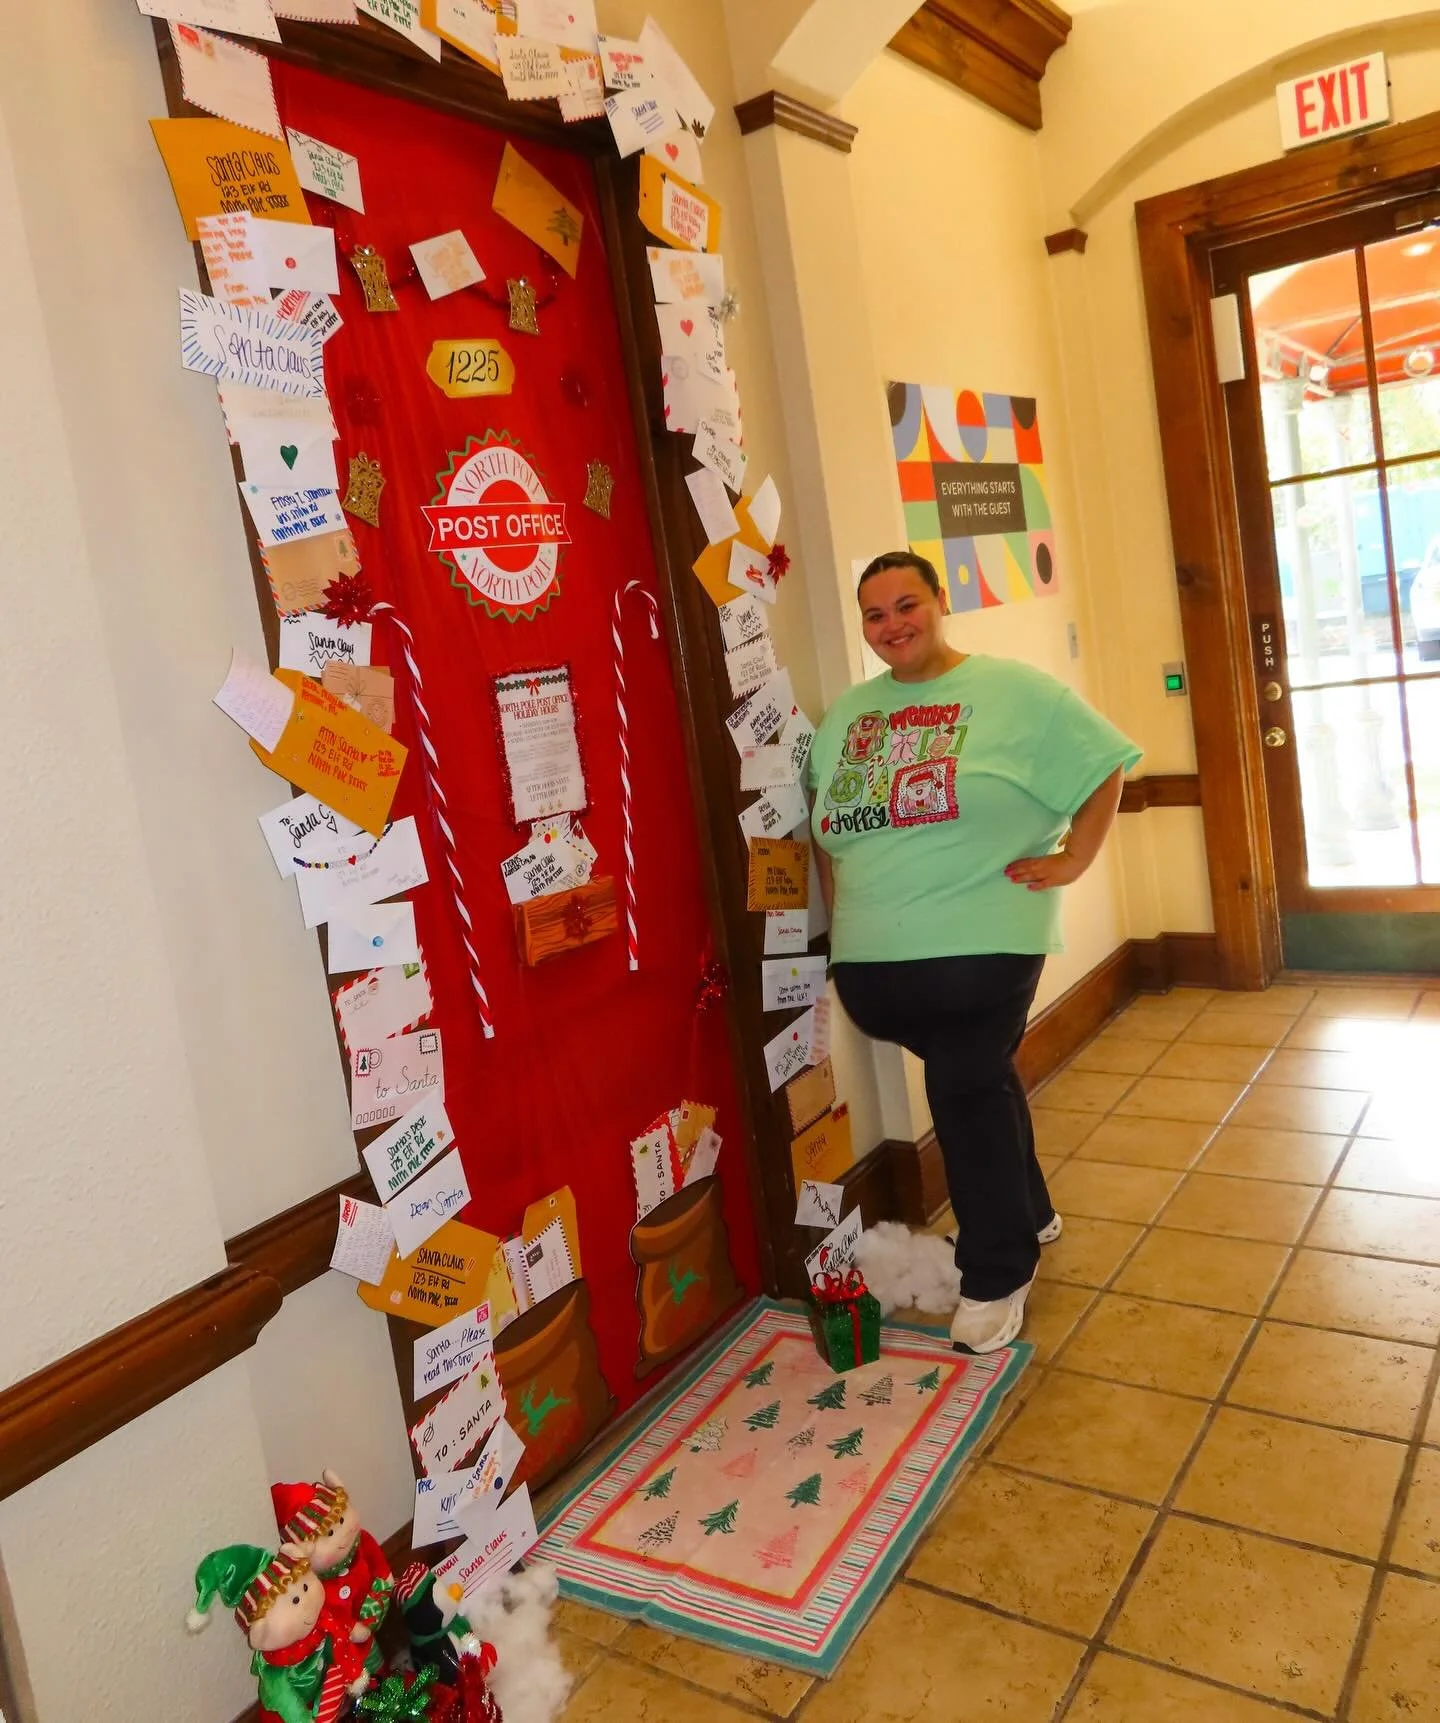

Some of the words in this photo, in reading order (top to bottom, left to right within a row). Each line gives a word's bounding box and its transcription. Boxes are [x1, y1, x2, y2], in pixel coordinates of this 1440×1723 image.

[1295, 61, 1370, 139] EXIT
[206, 152, 245, 187] Santa
[242, 150, 281, 178] Claus
[221, 185, 239, 199] 123
[213, 325, 276, 372] Santa
[277, 346, 312, 379] Claus
[446, 349, 500, 385] 1225
[455, 452, 509, 496] NORTH
[512, 454, 541, 496] POLE
[941, 481, 989, 496] EVERYTHING
[989, 480, 1016, 495] STARTS
[951, 502, 973, 518] WITH
[973, 502, 989, 516] THE
[988, 501, 1011, 515] GUEST
[438, 515, 500, 542] POST
[506, 513, 564, 538] OFFICE
[469, 557, 521, 601] NORTH
[522, 557, 552, 596] POLE
[308, 631, 336, 651] Santa
[1261, 623, 1275, 667] PUSH
[513, 706, 541, 721] HOLIDAY
[540, 704, 560, 717] HOURS
[520, 698, 536, 712] POLE
[536, 696, 551, 709] POST
[551, 693, 570, 706] OFFICE
[289, 812, 322, 849] Santa
[830, 804, 890, 835] Jolly
[376, 1078, 391, 1099] to
[396, 1065, 440, 1095] Santa
[654, 1140, 665, 1179] SANTA
[410, 1199, 433, 1220] Dear
[432, 1189, 464, 1216] Santa
[417, 1247, 443, 1267] SANTA
[441, 1252, 465, 1272] CLAUS
[412, 1271, 426, 1286] 123
[423, 1366, 441, 1385] read
[434, 1444, 449, 1463] TO
[459, 1399, 493, 1441] SANTA
[472, 1452, 490, 1481] Emma
[433, 1554, 460, 1578] awaii
[458, 1554, 486, 1585] Santa
[484, 1530, 508, 1556] Claus
